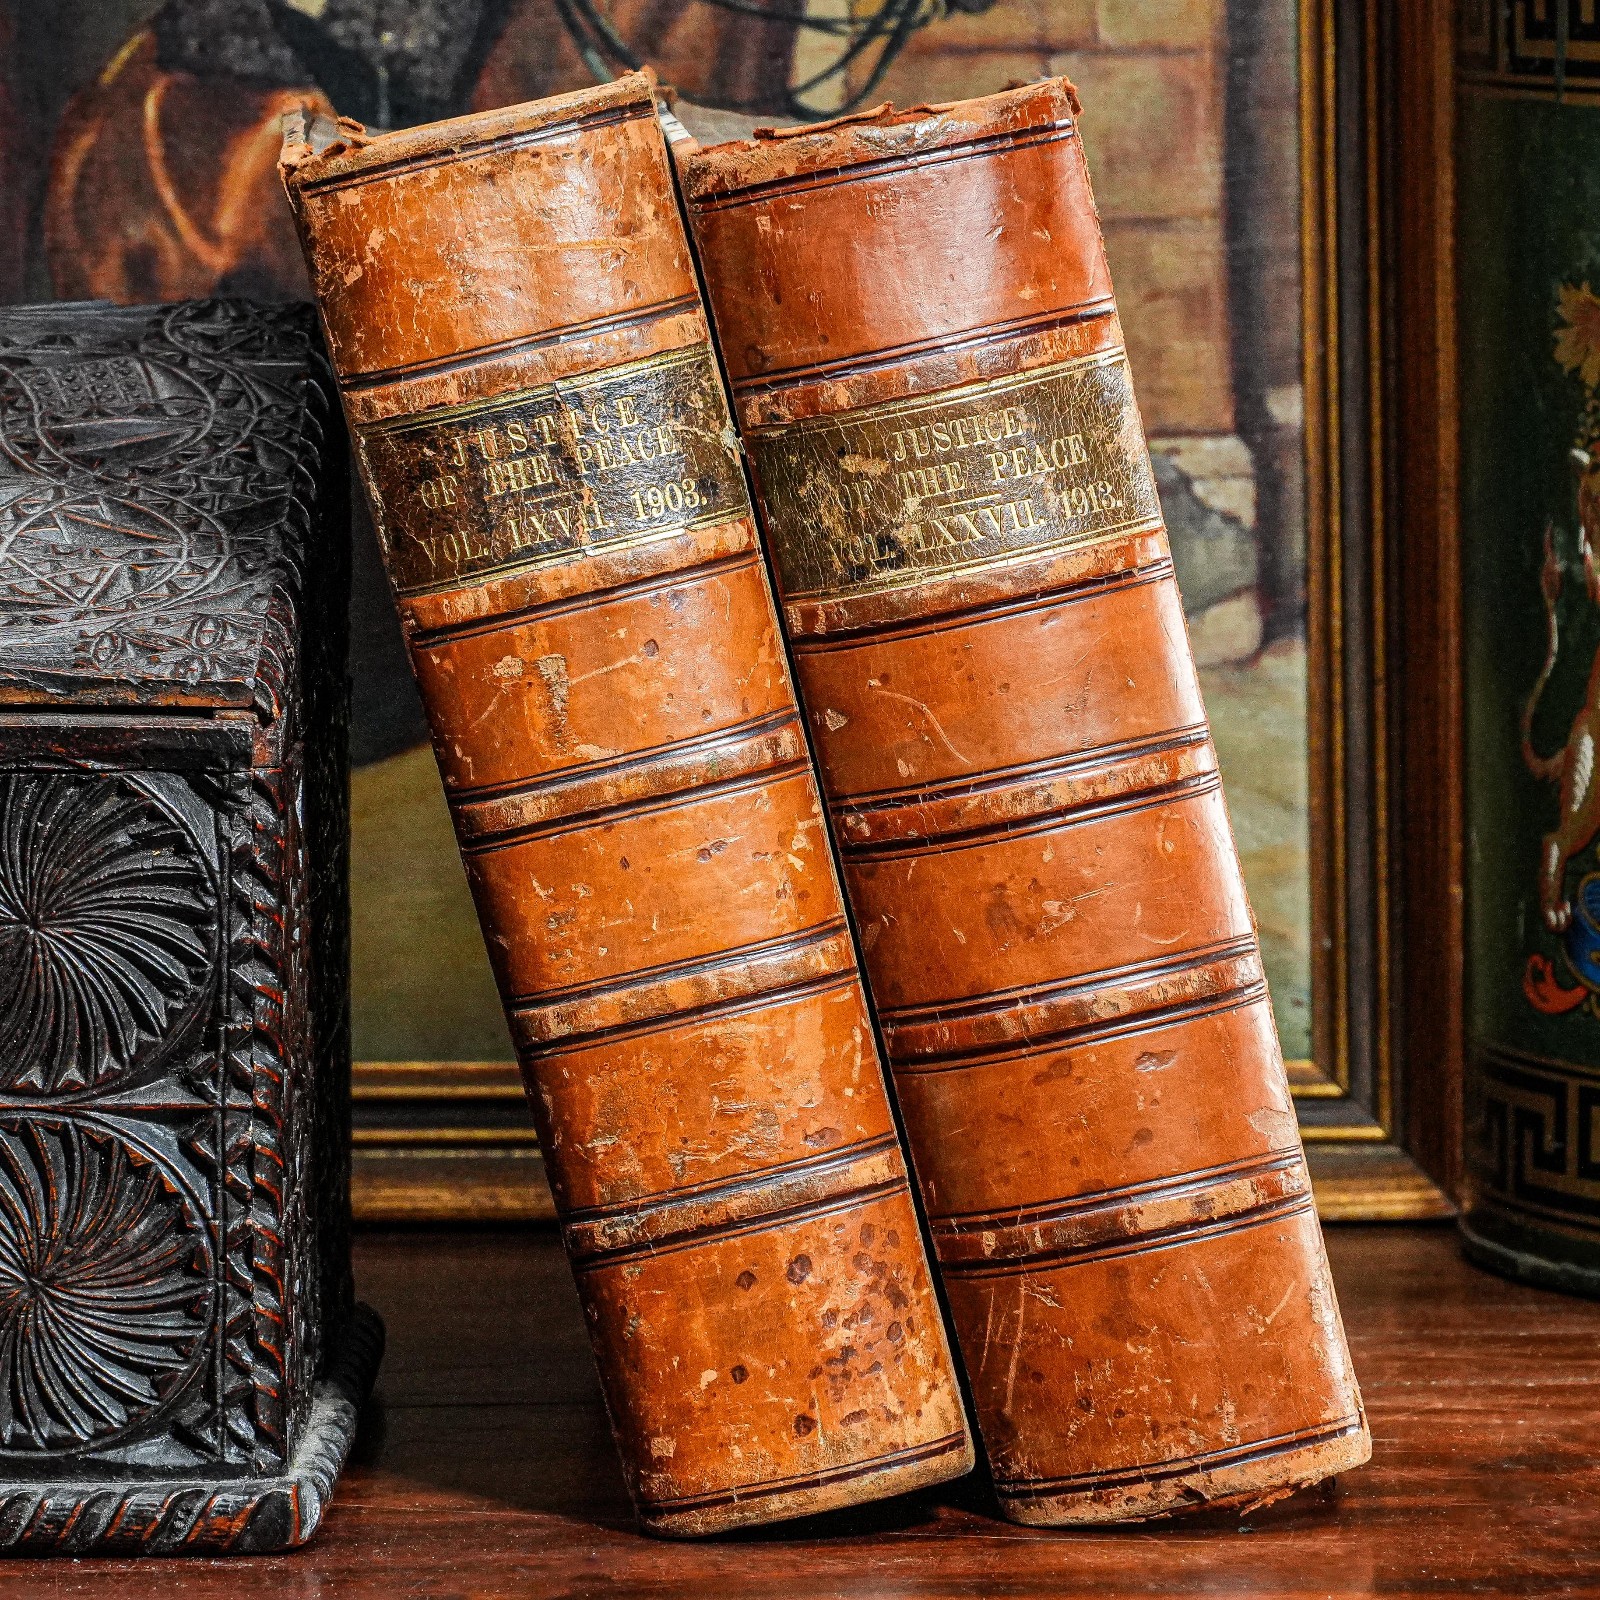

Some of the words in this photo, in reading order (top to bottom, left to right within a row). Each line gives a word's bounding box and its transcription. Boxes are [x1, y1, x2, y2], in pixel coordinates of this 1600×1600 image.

[452, 397, 639, 467] JUSTICE
[893, 407, 1023, 461] JUSTICE
[421, 475, 458, 510] OF
[485, 456, 553, 497] THE
[577, 426, 676, 475] PEACE
[895, 462, 966, 500] THE
[991, 435, 1087, 484] PEACE
[632, 479, 708, 521] 1903.
[1060, 482, 1122, 519] 1913.
